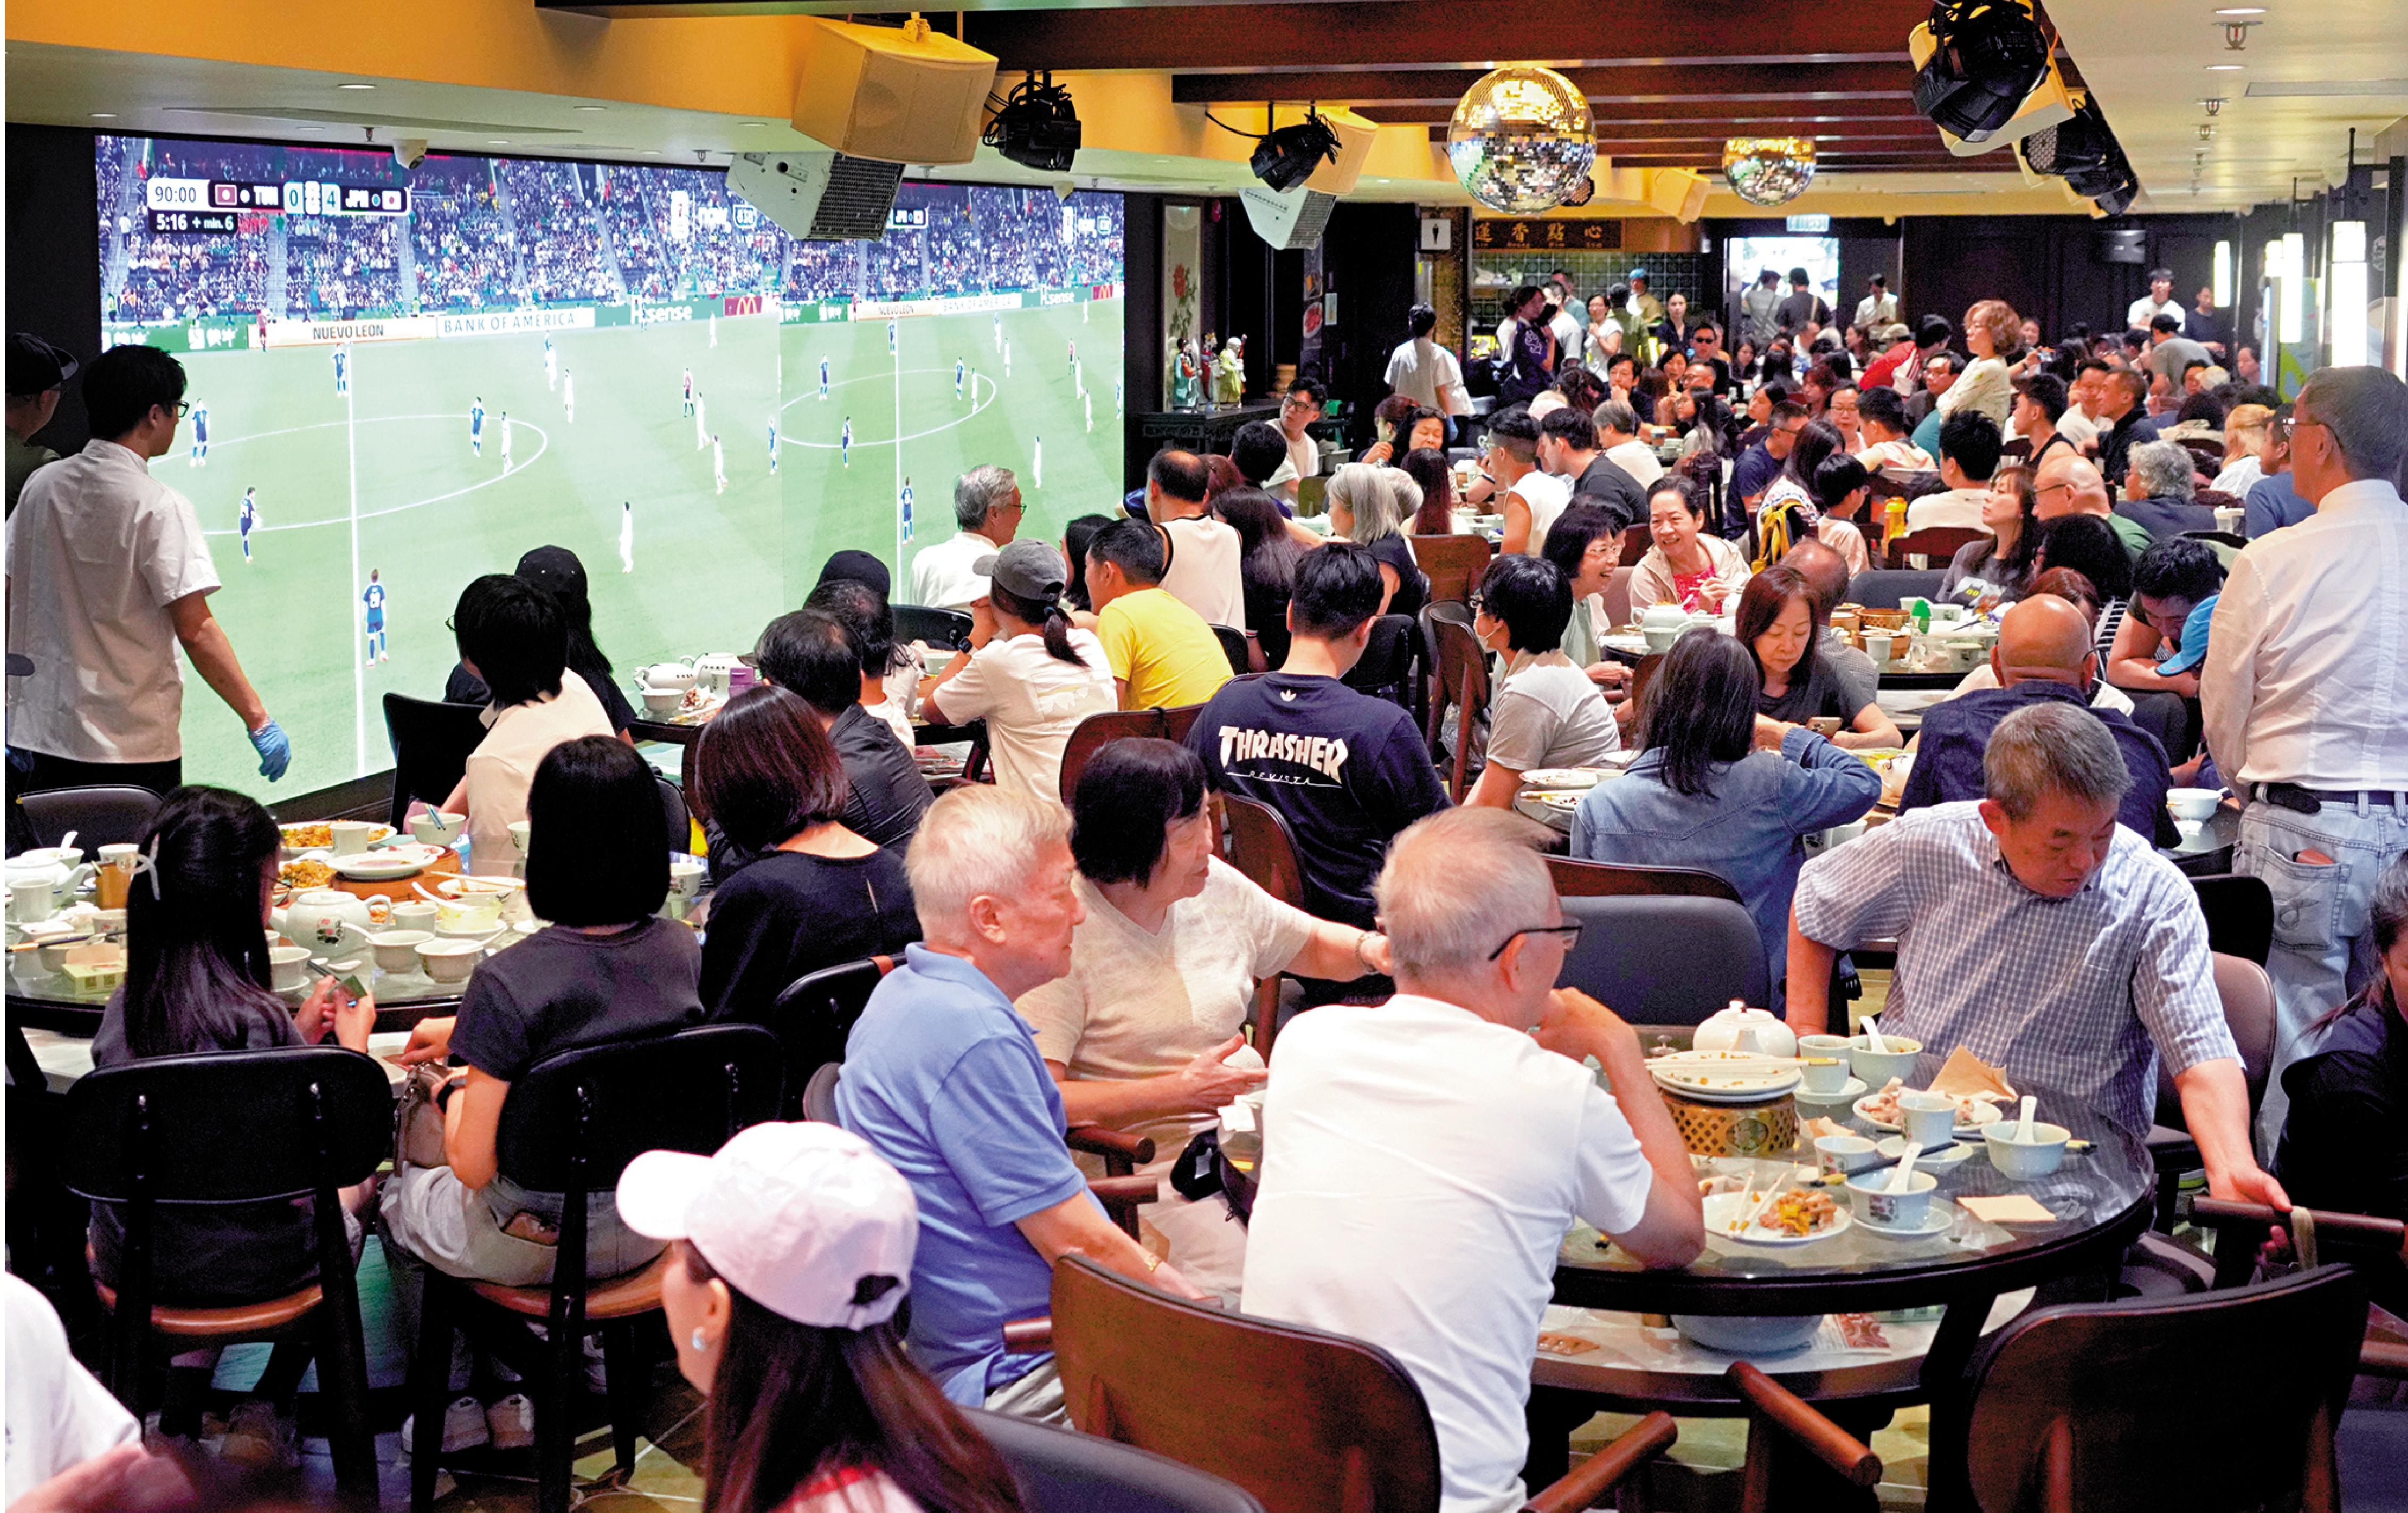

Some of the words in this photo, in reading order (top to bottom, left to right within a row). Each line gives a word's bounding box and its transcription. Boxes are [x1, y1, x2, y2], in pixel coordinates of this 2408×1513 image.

[154, 186, 197, 203] 90:00
[289, 189, 298, 207] 0
[327, 190, 337, 208] 4
[157, 213, 188, 231] 5:16
[444, 318, 485, 333] BANK
[491, 316, 507, 330] OF
[513, 312, 575, 328] AMERICA
[631, 301, 692, 324] Hsense
[313, 325, 353, 340] NUEVO
[1219, 725, 1348, 784] THRASHER
